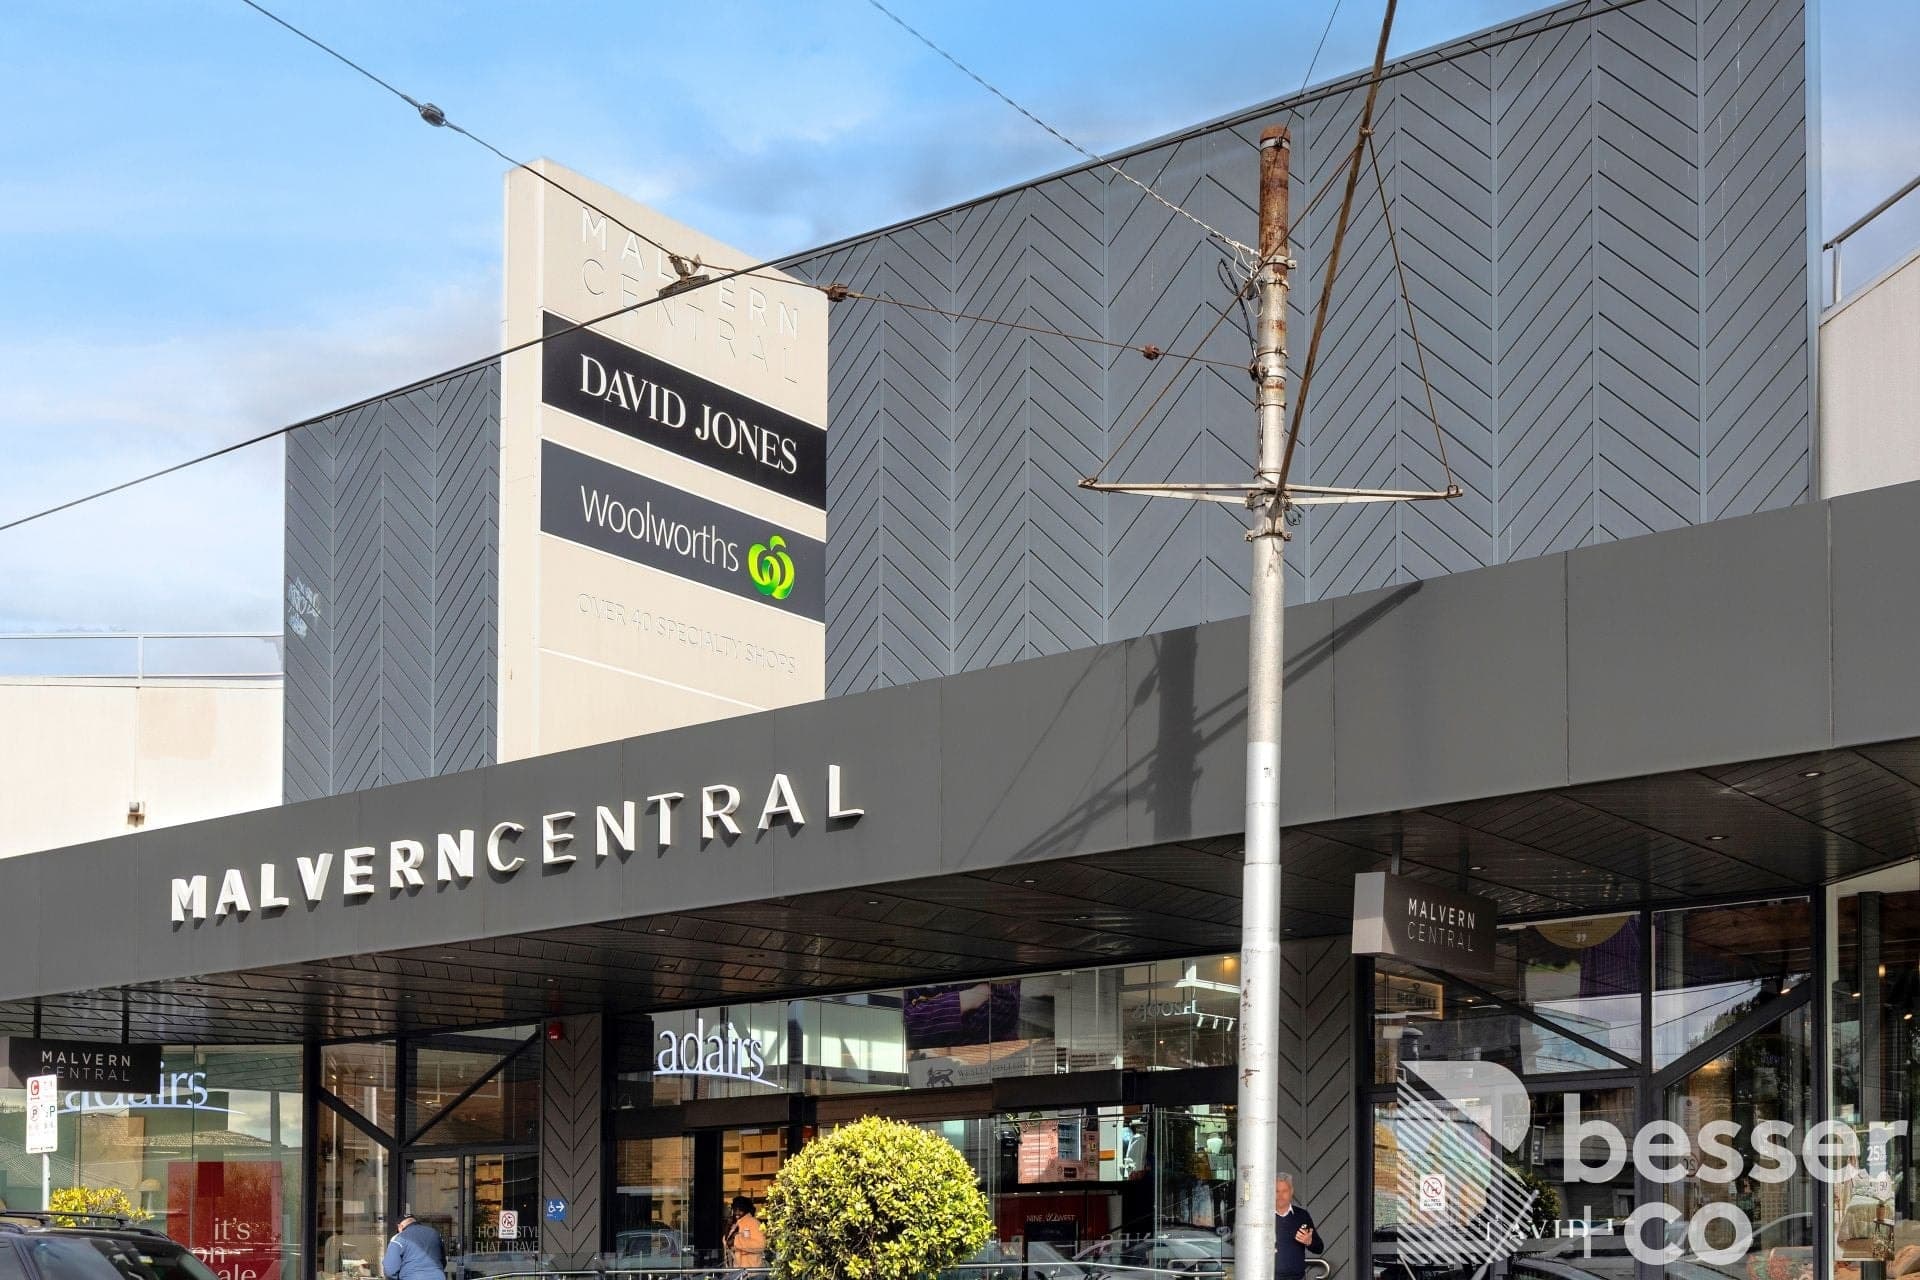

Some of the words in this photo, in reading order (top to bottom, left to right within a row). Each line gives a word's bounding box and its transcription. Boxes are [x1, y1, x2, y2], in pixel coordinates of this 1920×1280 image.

[579, 353, 687, 429] DAVID
[694, 403, 798, 474] JONES
[580, 484, 739, 572] Woolworths
[577, 592, 627, 626] OVER
[631, 608, 652, 631] 40
[655, 616, 742, 660] SPECIALTY
[744, 643, 798, 675] SHOPS
[1407, 897, 1475, 930] MALVERN
[1407, 921, 1474, 952] CENTRAL
[41, 1050, 131, 1067] MALVERN
[657, 1018, 764, 1080] adairs
